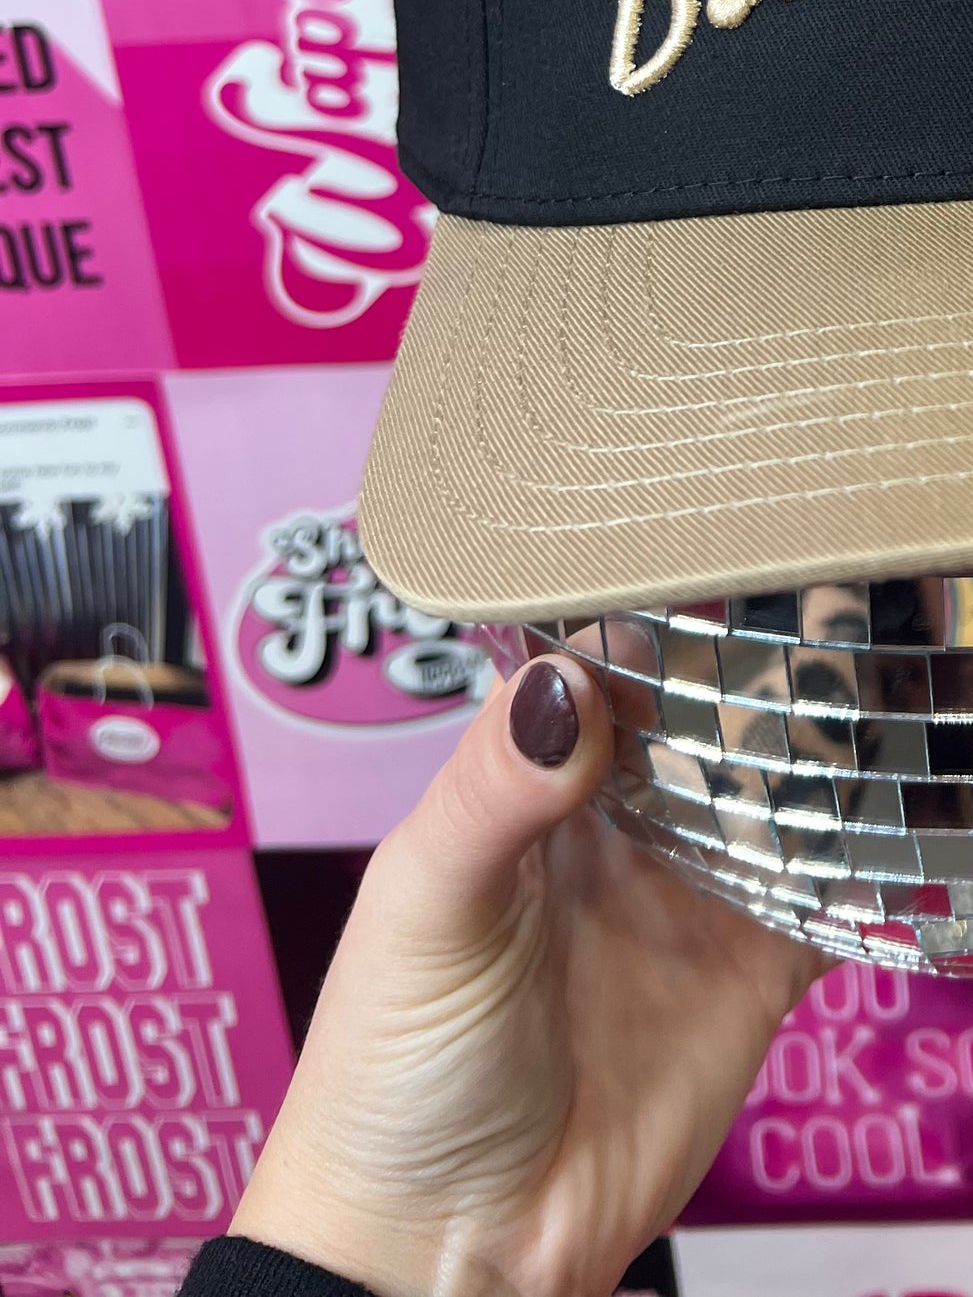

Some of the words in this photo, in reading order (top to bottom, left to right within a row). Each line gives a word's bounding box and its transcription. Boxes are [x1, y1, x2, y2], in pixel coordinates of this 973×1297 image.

[781, 959, 911, 1022] OU
[2, 1110, 263, 1222] FROST
[750, 1104, 962, 1194] COOL
